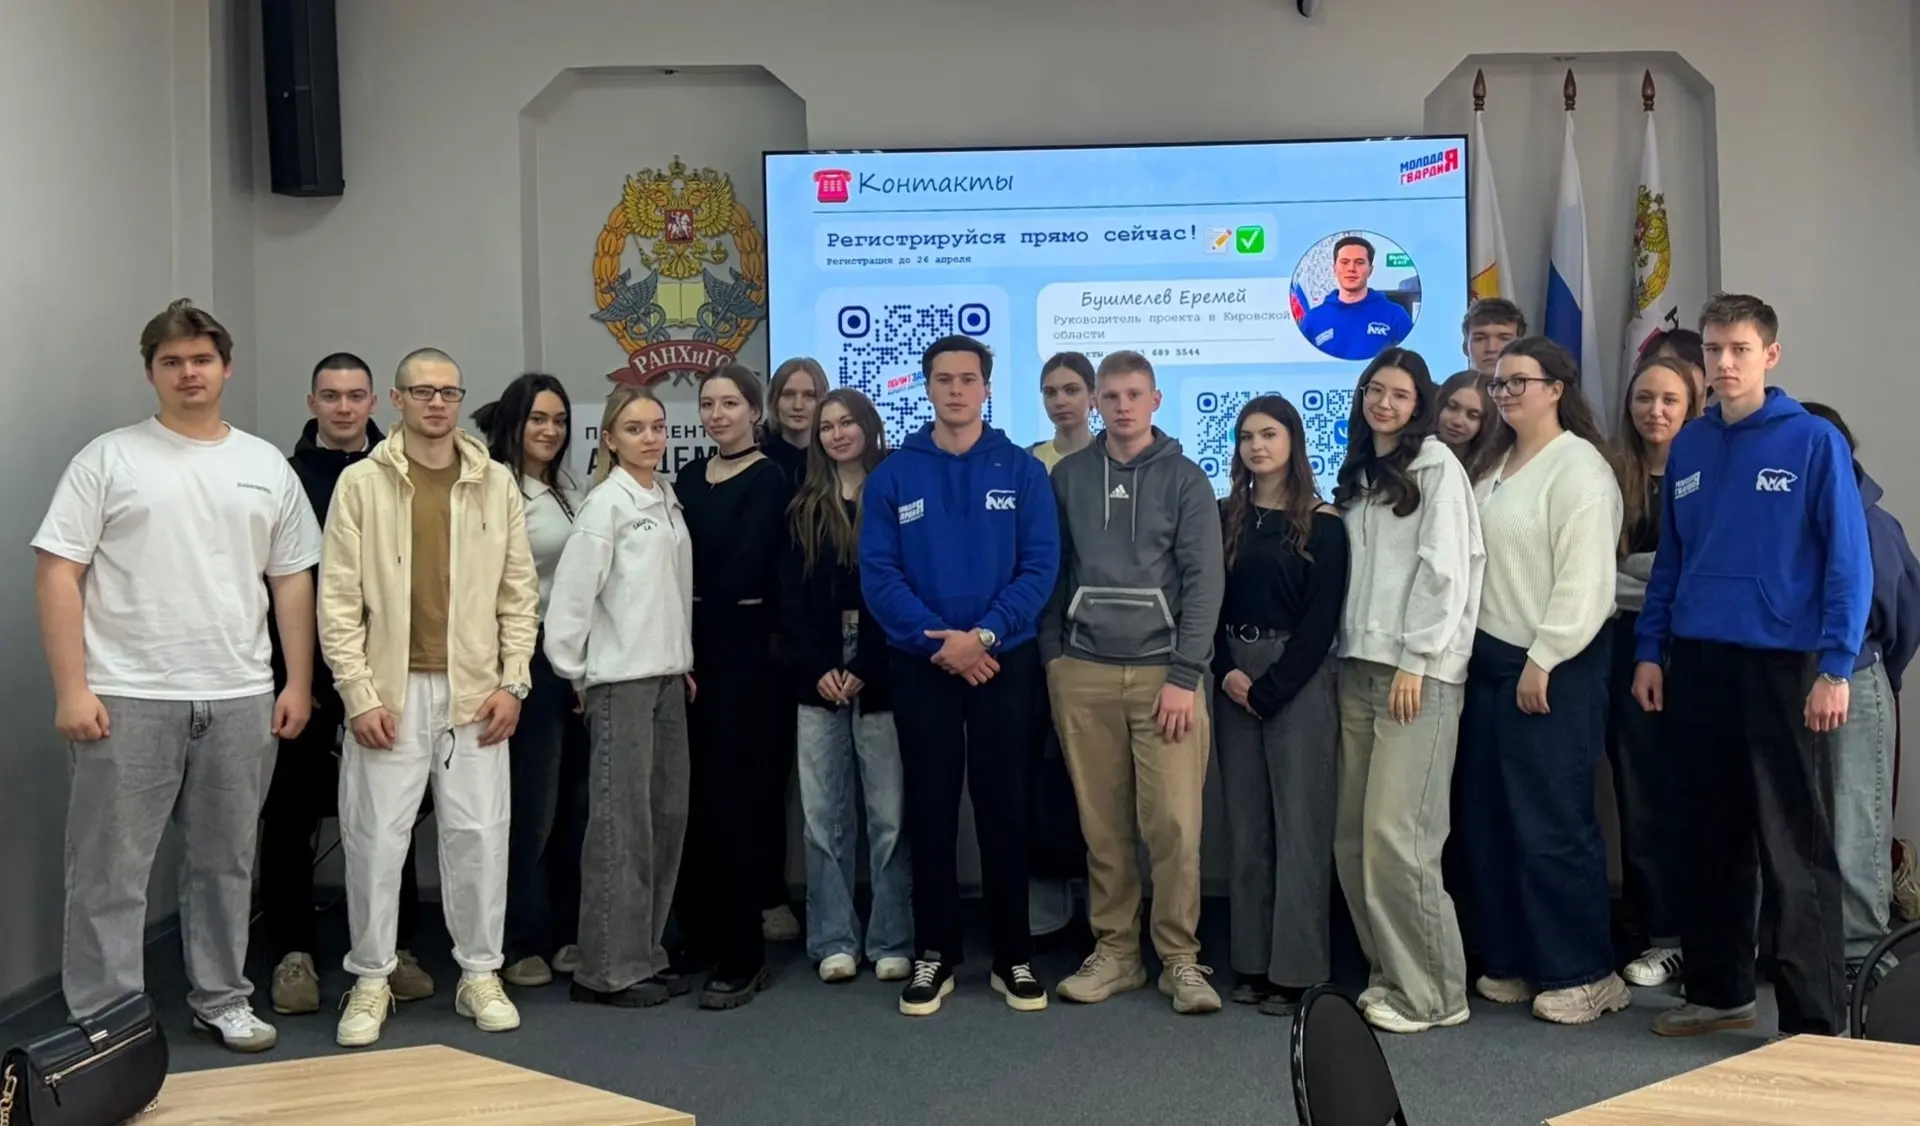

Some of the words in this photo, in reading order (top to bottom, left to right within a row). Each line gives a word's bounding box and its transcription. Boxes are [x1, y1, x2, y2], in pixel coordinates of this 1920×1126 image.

[1400, 148, 1458, 173] МОЛОДАЯ
[859, 172, 1014, 194] Контакты
[827, 228, 1006, 250] Регистрируйся
[1020, 231, 1089, 247] прямо
[1104, 224, 1196, 242] сейчас!
[826, 258, 893, 266] Регистрация
[898, 257, 911, 265] до
[917, 256, 929, 264] 26
[935, 255, 972, 265] апреля
[1081, 289, 1172, 311] Бушмелев
[1179, 288, 1247, 308] Еремей
[1053, 314, 1141, 325] Руководитель
[1149, 313, 1201, 323] проекта
[1223, 311, 1290, 322] Кировской
[1053, 330, 1105, 340] области
